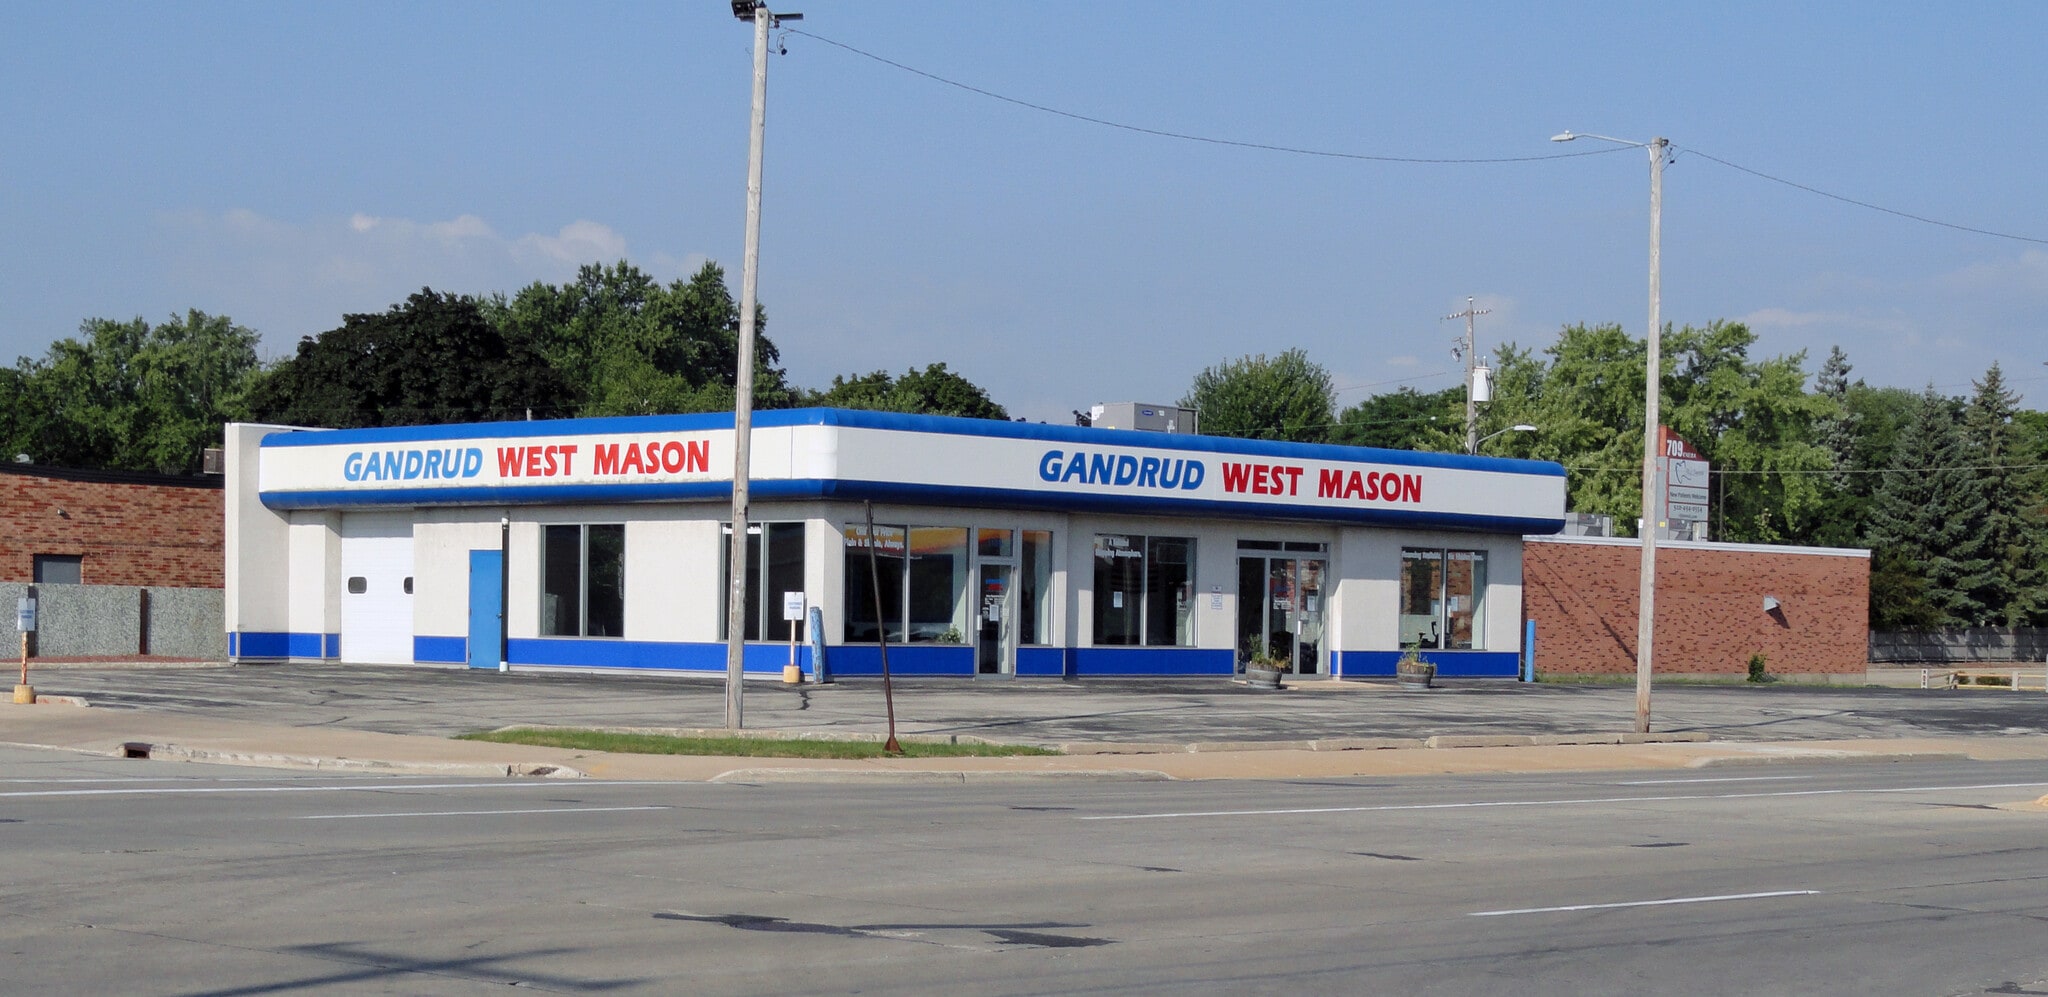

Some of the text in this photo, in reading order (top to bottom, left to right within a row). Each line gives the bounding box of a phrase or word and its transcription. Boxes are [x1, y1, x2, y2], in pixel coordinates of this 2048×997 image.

[344, 440, 710, 481] GANDRUD WEST MASON
[1667, 440, 1683, 457] 709
[1038, 449, 1423, 503] GANDRUD WEST MASON
